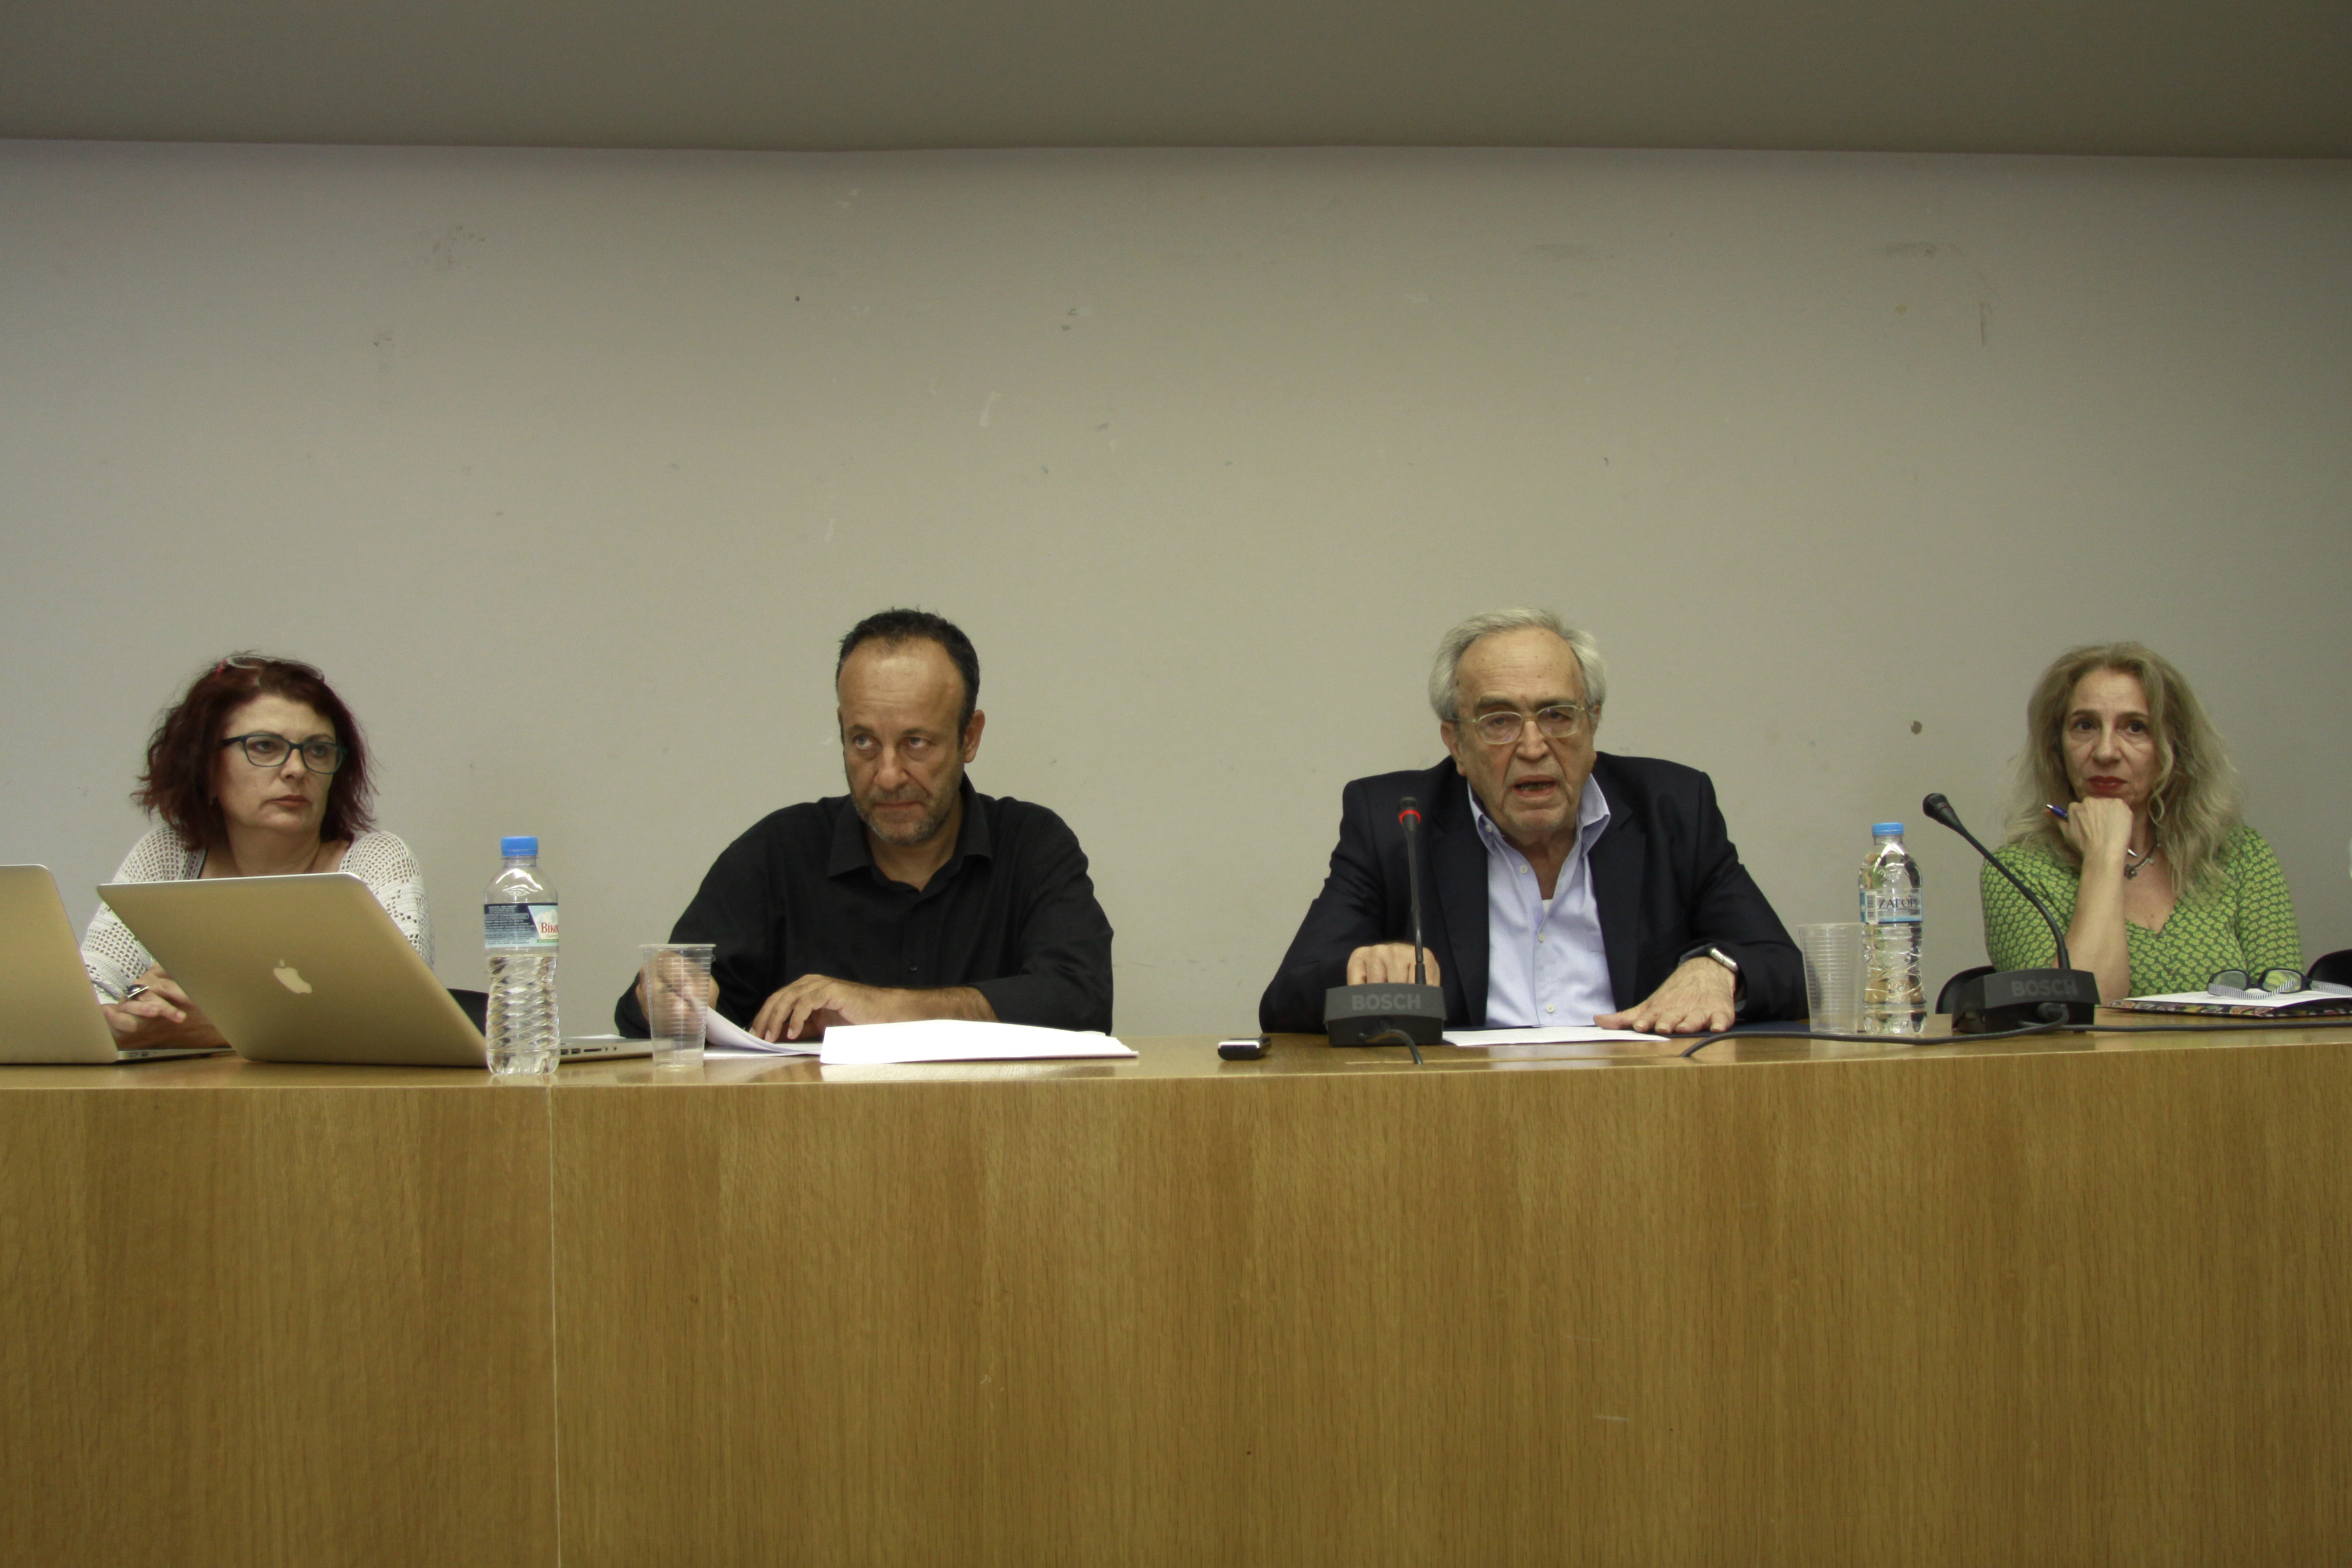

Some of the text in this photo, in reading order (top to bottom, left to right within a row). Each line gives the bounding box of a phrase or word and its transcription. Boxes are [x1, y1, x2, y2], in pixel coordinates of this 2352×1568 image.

[540, 921, 559, 933] Βίκο
[2011, 979, 2078, 997] BOSCH
[1352, 994, 1421, 1010] BOSCH
